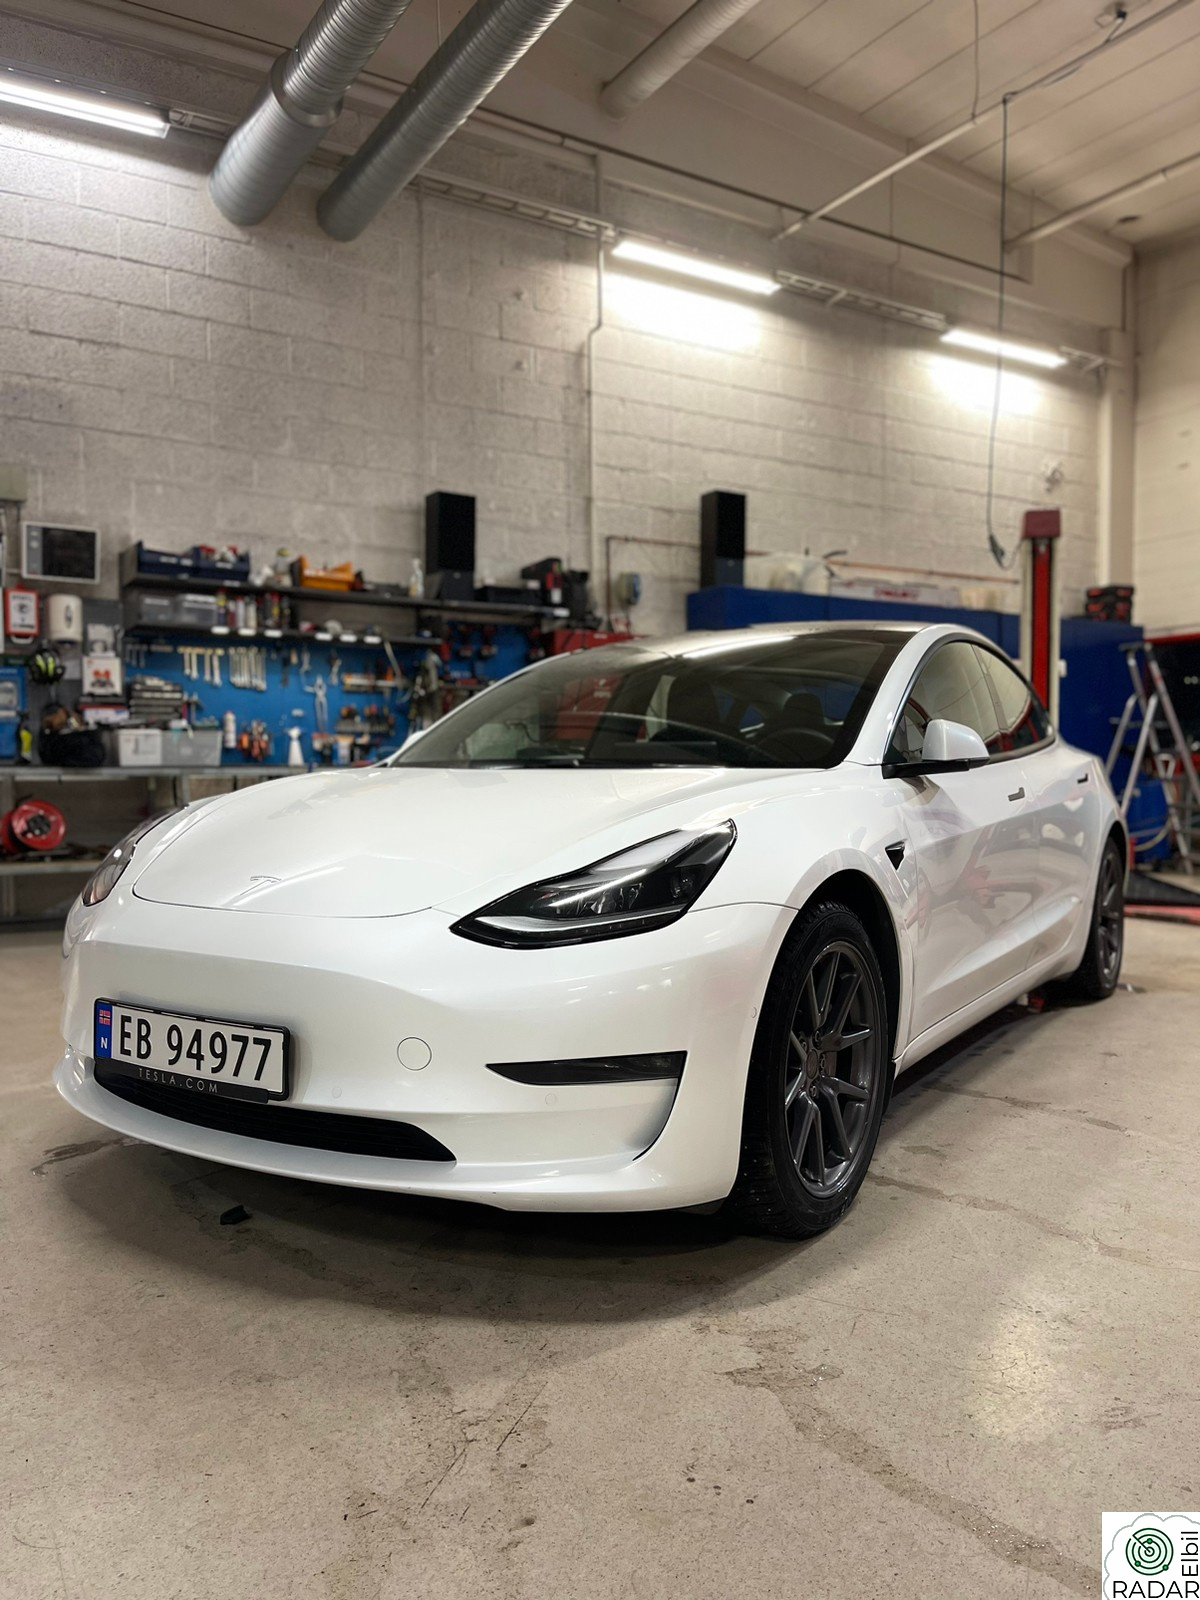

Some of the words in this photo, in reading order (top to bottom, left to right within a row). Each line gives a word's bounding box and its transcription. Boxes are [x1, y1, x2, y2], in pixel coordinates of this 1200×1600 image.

[101, 1037, 108, 1049] N
[120, 1014, 152, 1060] EB
[166, 1024, 272, 1081] 94977
[138, 1068, 219, 1094] TESLA.COM
